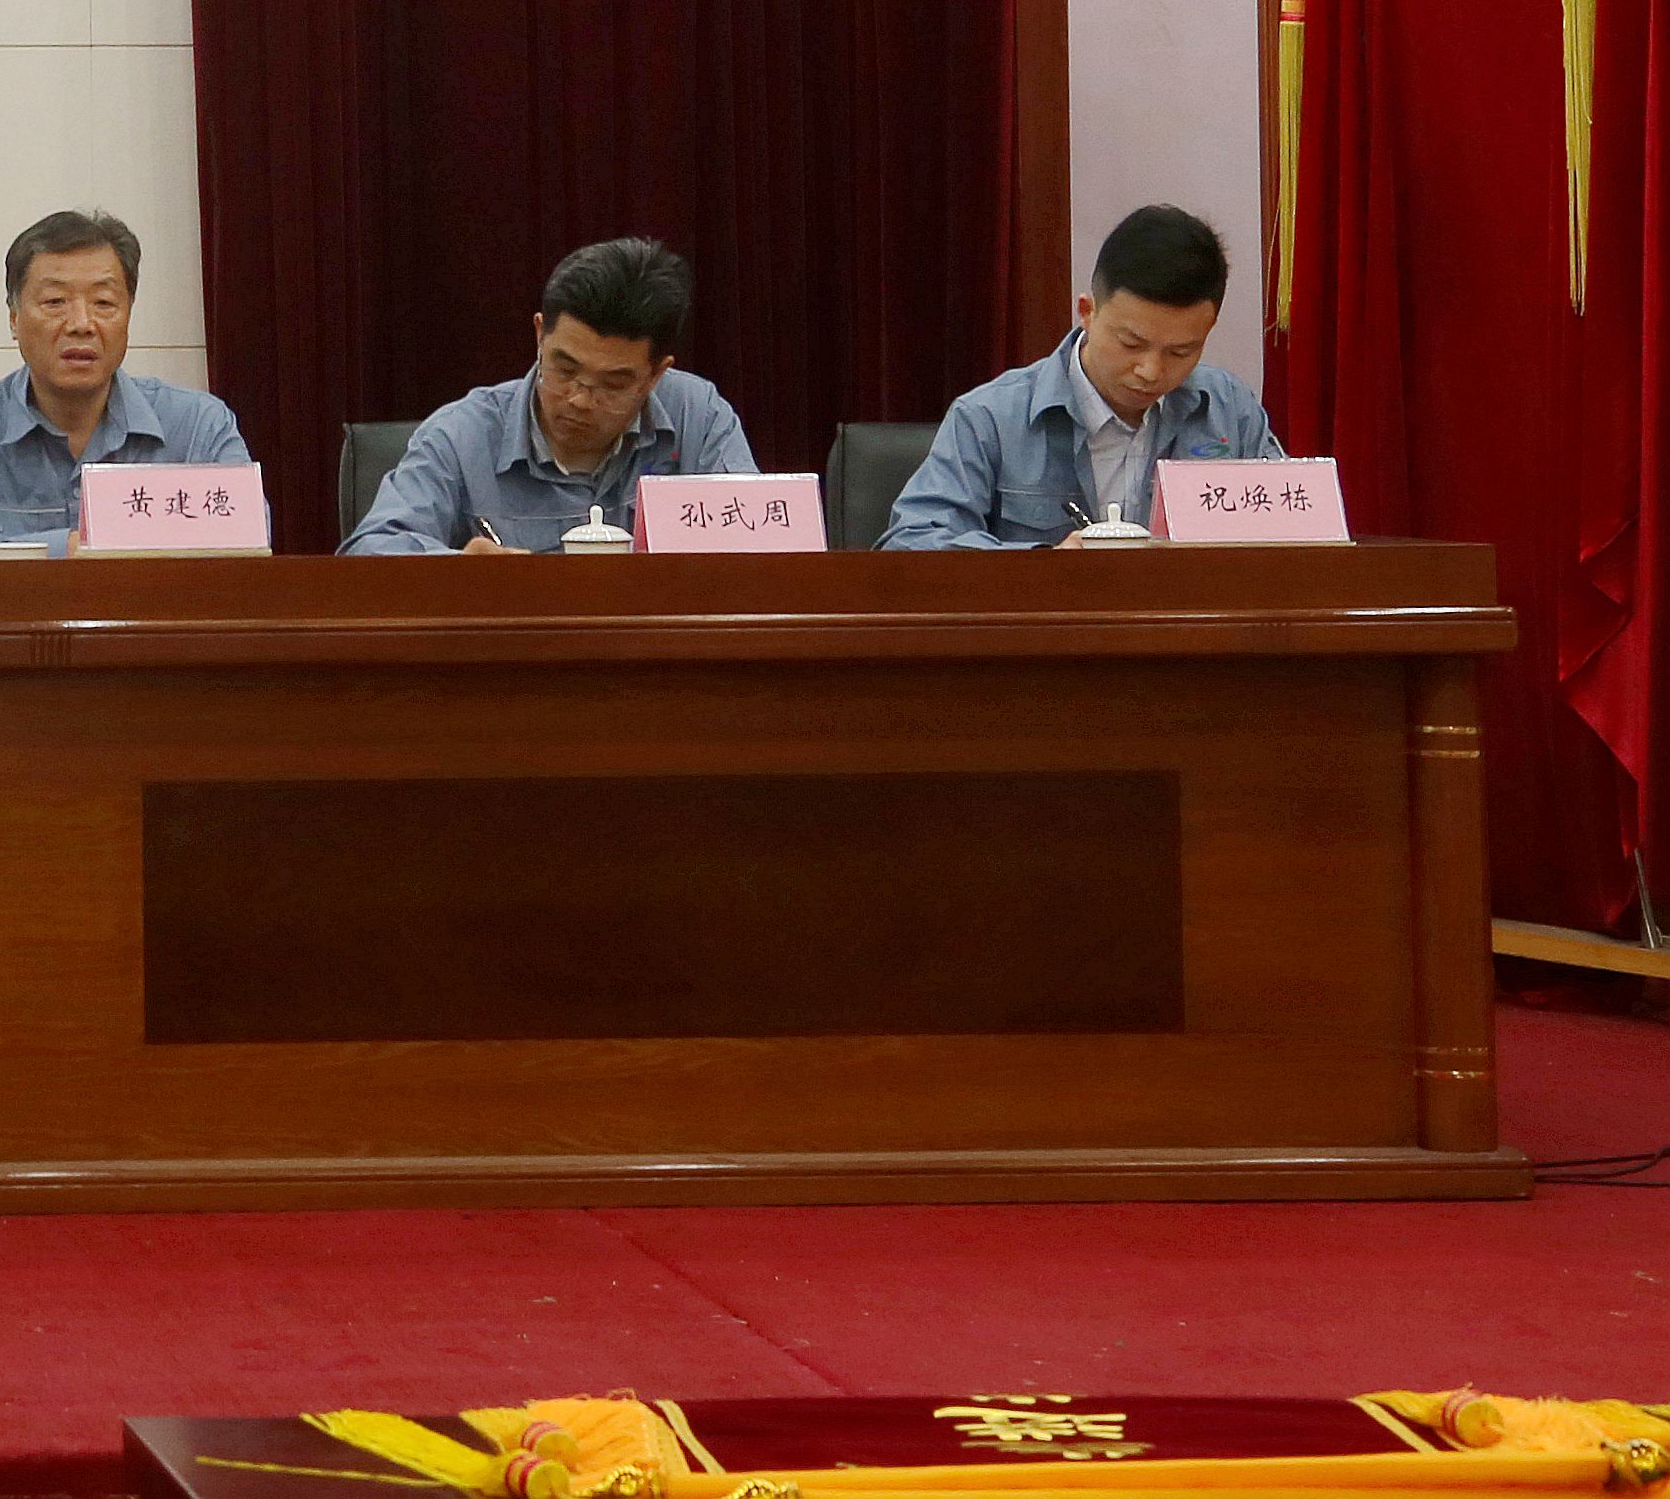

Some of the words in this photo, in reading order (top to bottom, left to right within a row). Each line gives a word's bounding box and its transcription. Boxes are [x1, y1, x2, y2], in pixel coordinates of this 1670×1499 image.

[121, 485, 237, 519] 黄建德
[679, 496, 792, 532] 孙武周
[1198, 481, 1313, 514] 祝焕栋
